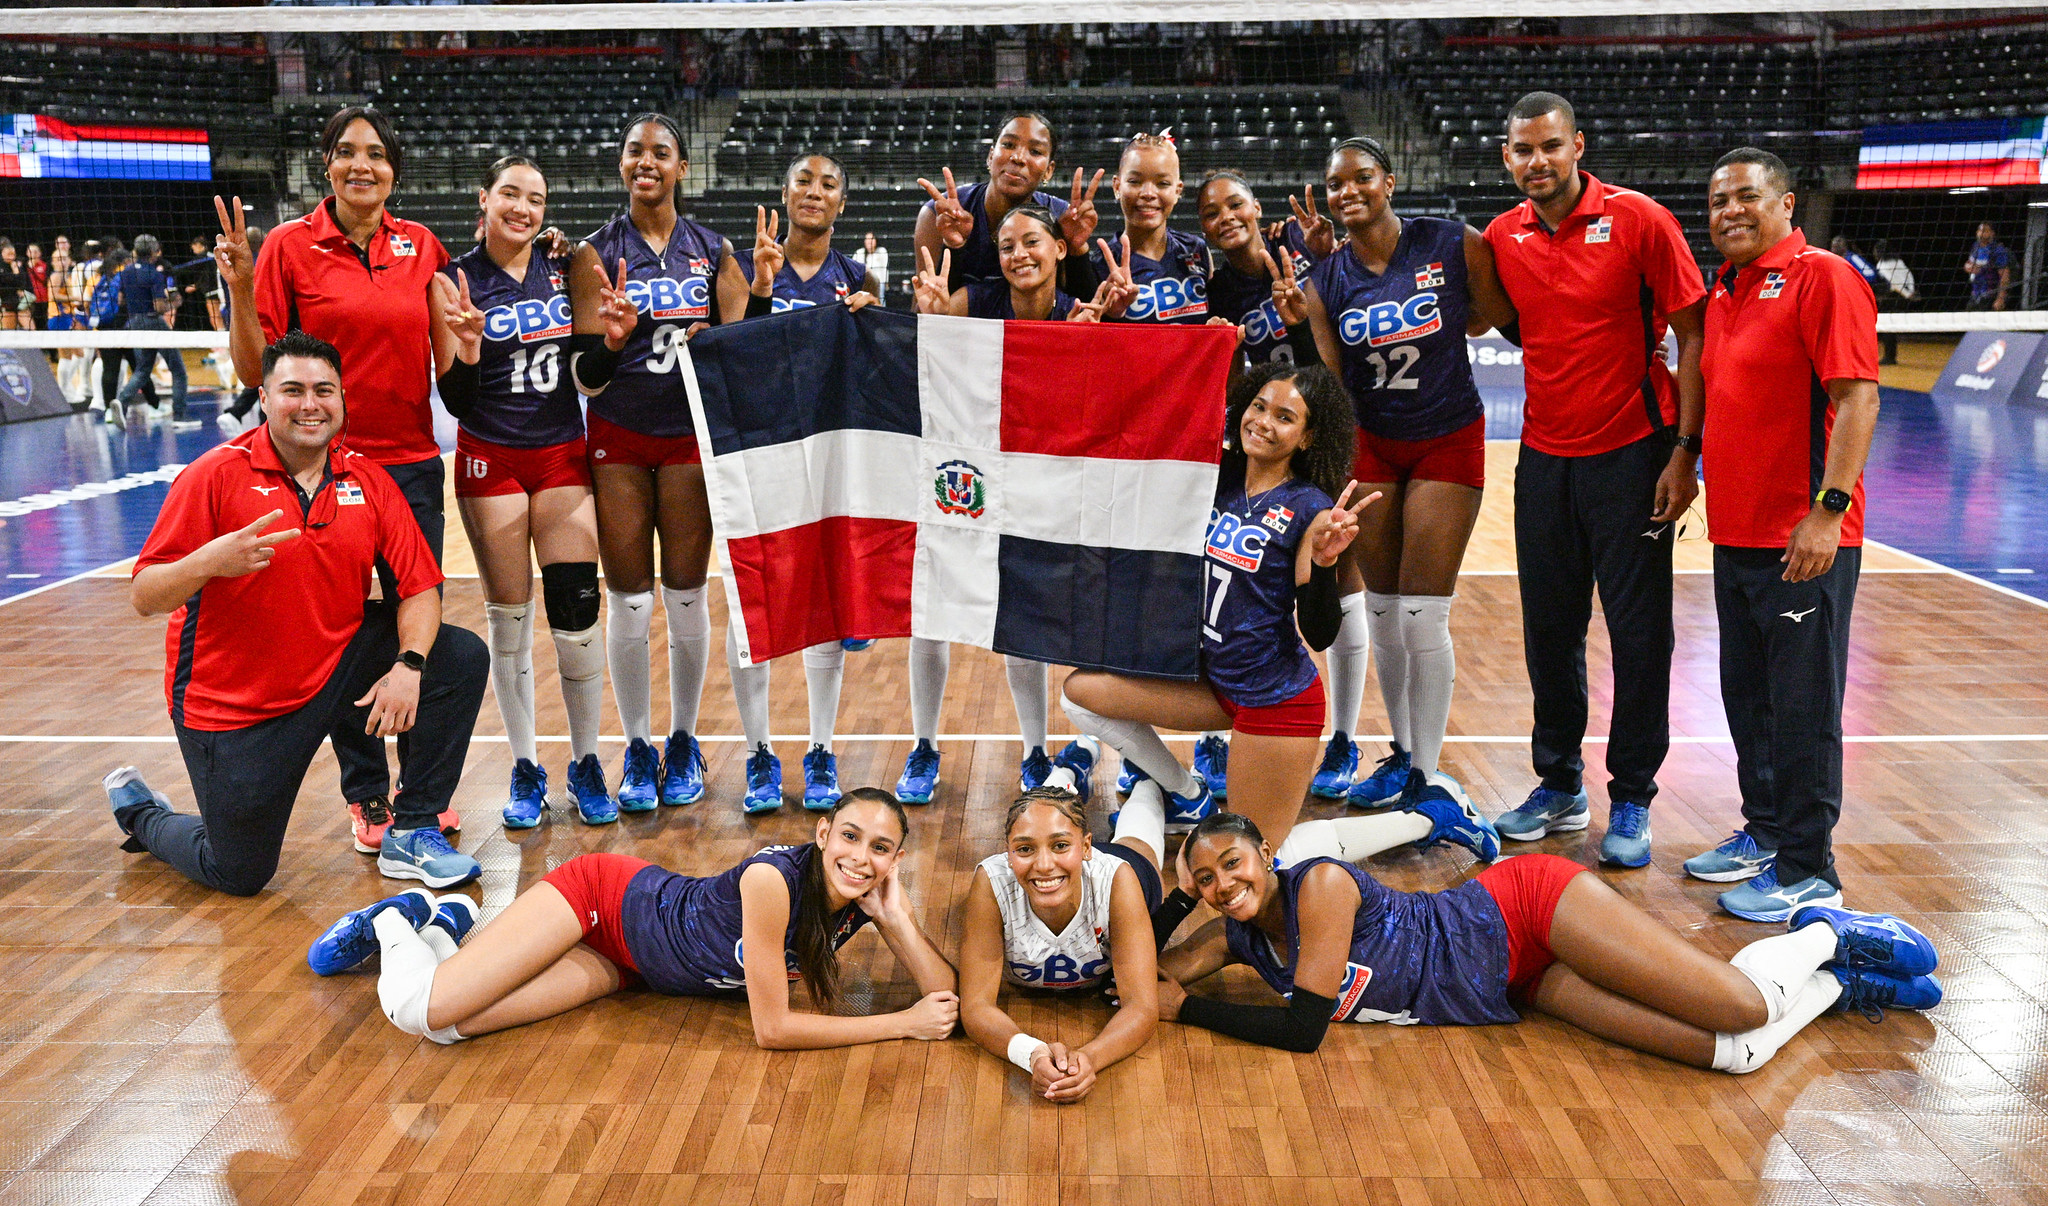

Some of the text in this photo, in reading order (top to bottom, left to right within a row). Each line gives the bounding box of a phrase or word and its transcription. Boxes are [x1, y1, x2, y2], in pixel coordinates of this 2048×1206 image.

[625, 277, 710, 316] GBC
[1125, 275, 1207, 319] GBC
[1421, 279, 1441, 287] DOM
[483, 294, 573, 341] GBC
[1339, 293, 1440, 346] GBC
[1379, 324, 1436, 342] FARMACIAS
[509, 344, 560, 393] 10
[646, 323, 681, 374] 9
[1365, 345, 1420, 390] 12
[466, 456, 488, 478] 10
[1265, 518, 1284, 531] DOM
[1212, 549, 1252, 569] FARMACIAS
[1336, 975, 1367, 1019] FARMACIAS
